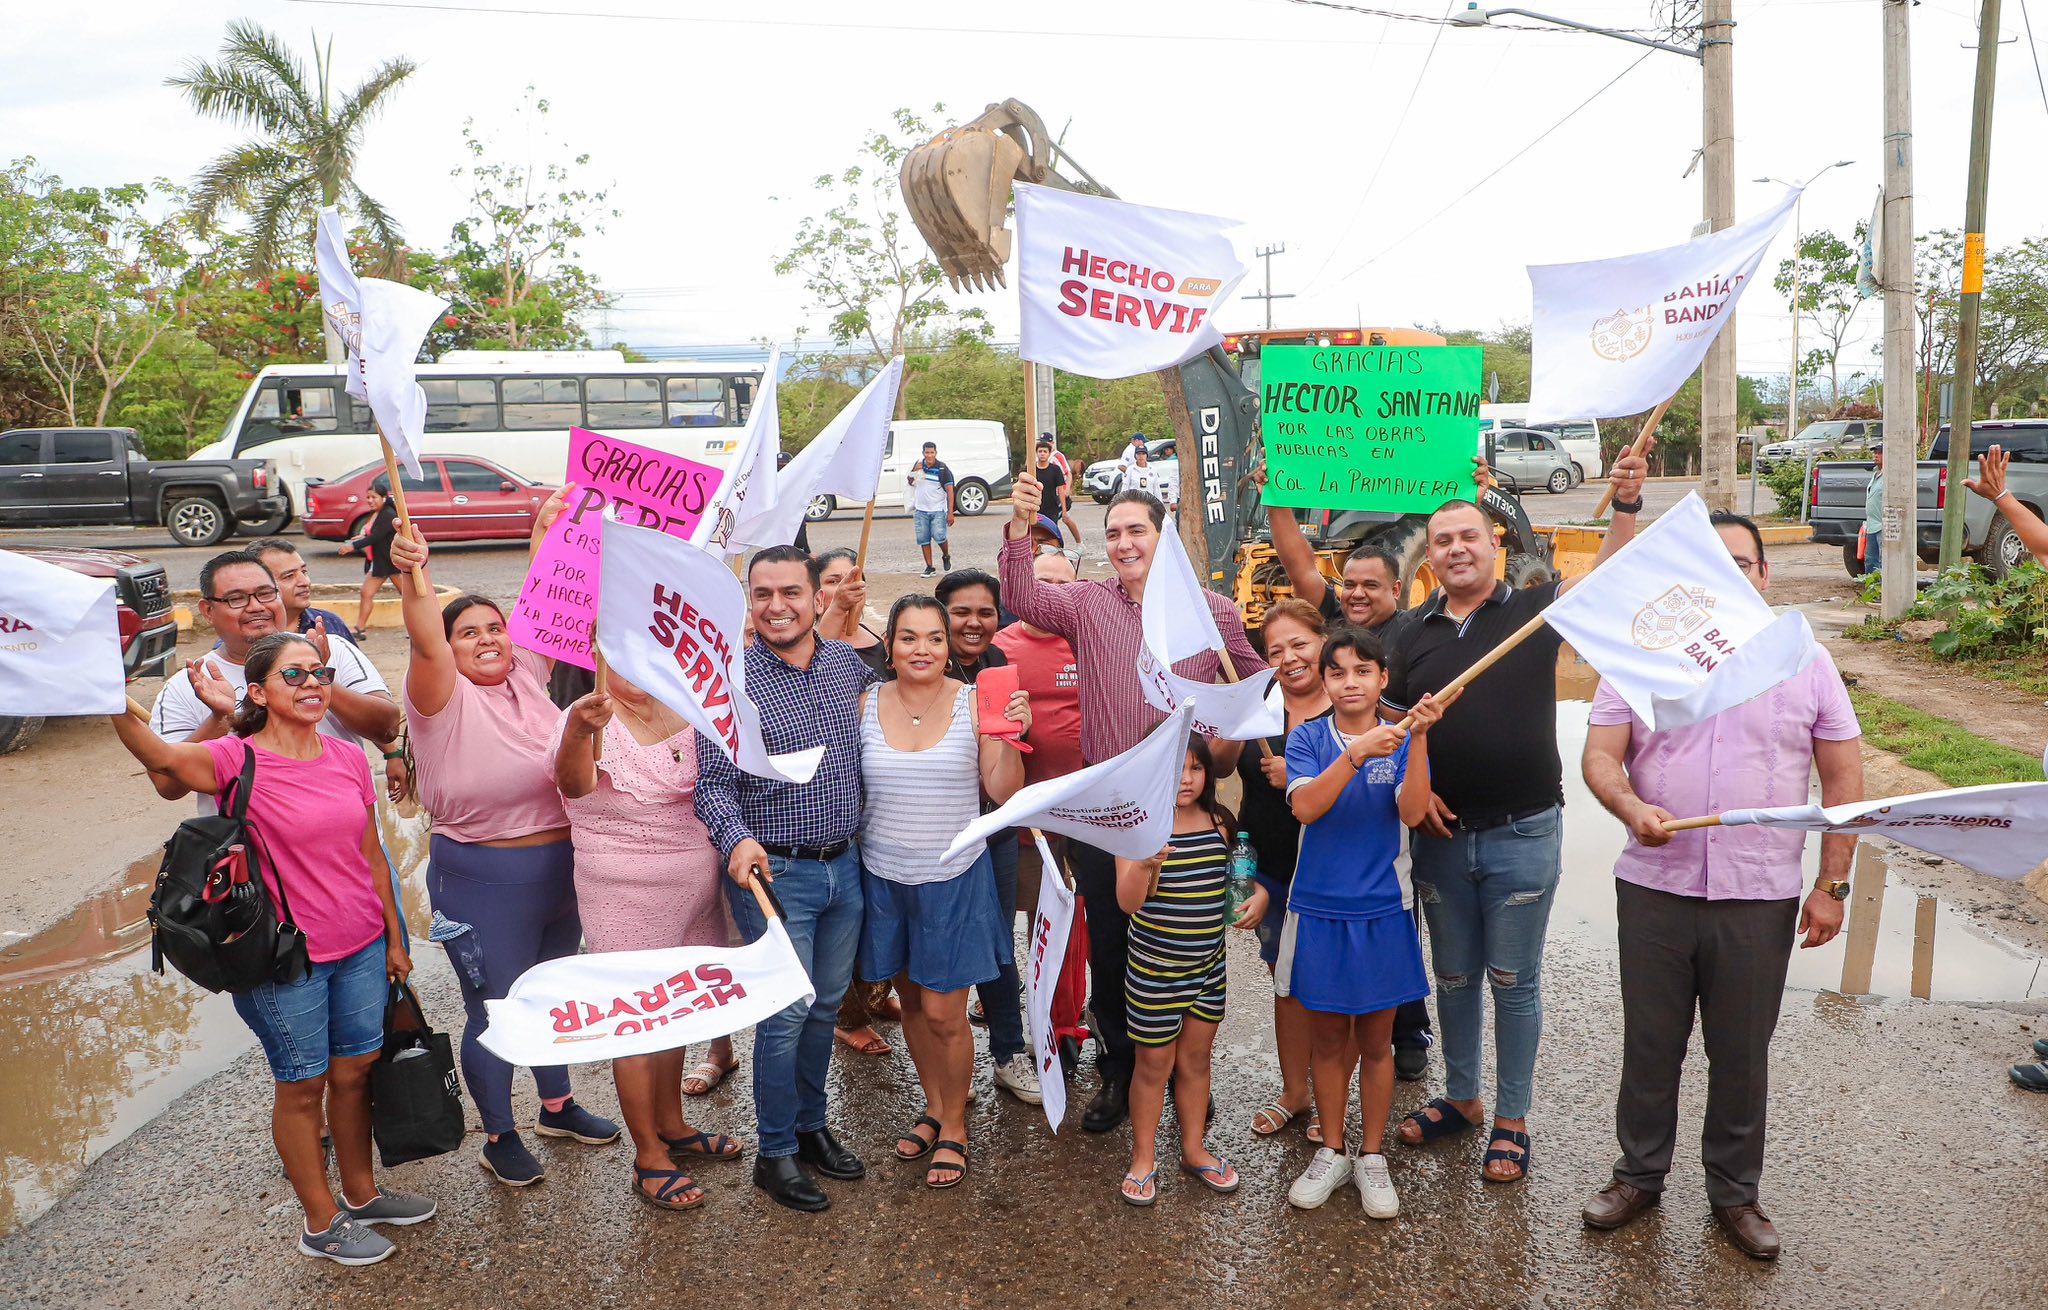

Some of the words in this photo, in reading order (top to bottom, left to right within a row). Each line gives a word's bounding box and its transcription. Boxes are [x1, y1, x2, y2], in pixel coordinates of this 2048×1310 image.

[1061, 246, 1175, 293] HECHO
[1187, 281, 1212, 292] PARA
[1312, 350, 1424, 375] GRACIAS
[1263, 382, 1364, 418] HECTOR
[1377, 388, 1481, 419] SANTANA
[1277, 421, 1308, 436] POR
[1325, 425, 1355, 441] LAS
[1365, 425, 1426, 443] OBRAS
[1199, 406, 1225, 525] DEERE
[1275, 443, 1349, 459] PUBLICAS
[1371, 447, 1395, 460] EN
[581, 439, 707, 516] GRACIAS
[1349, 468, 1459, 497] PRIMAVERA
[553, 560, 586, 585] POR
[529, 576, 541, 593] Y
[547, 583, 593, 610] HACER
[1080, 806, 1141, 822] sueños
[1103, 800, 1136, 813] donde
[613, 983, 748, 1036] HECHO
